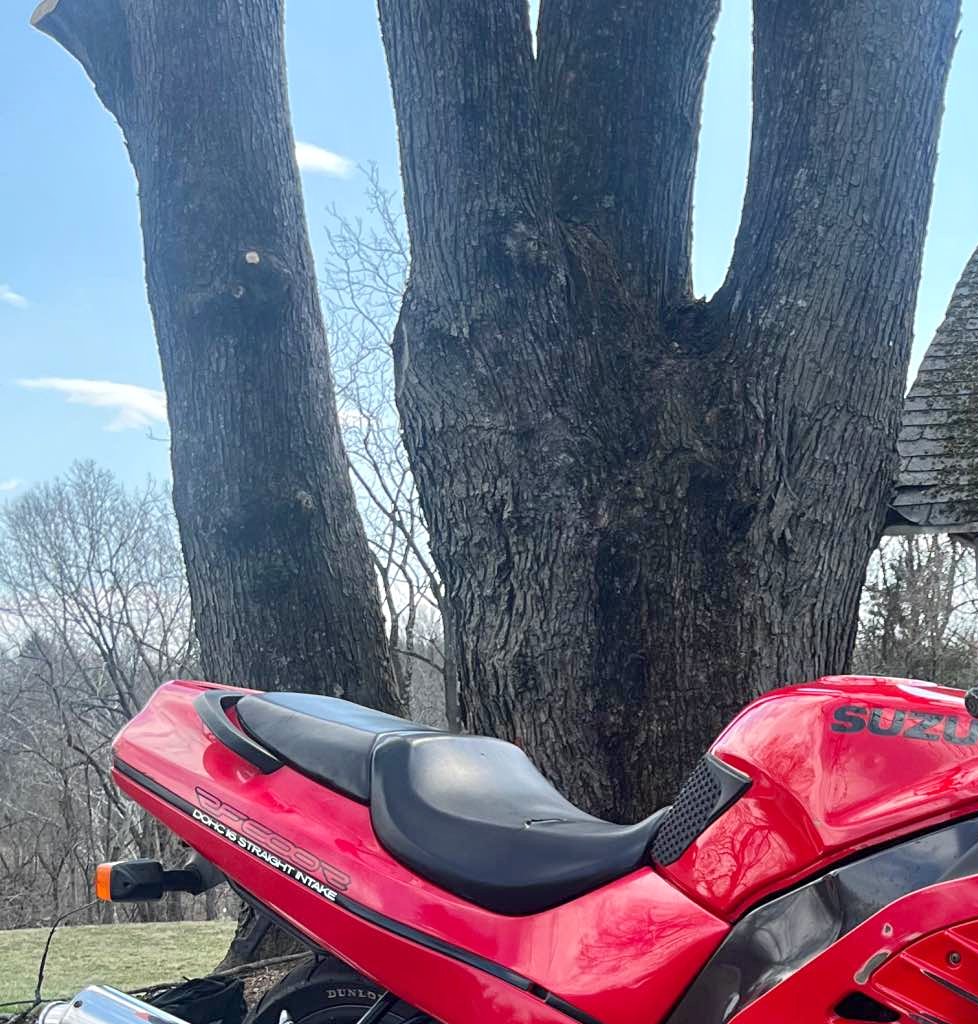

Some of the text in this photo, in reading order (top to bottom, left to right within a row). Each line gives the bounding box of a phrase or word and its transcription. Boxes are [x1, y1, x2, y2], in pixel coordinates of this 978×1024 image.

[192, 808, 338, 901] DOHC 16 STRAIGHT INTAKE
